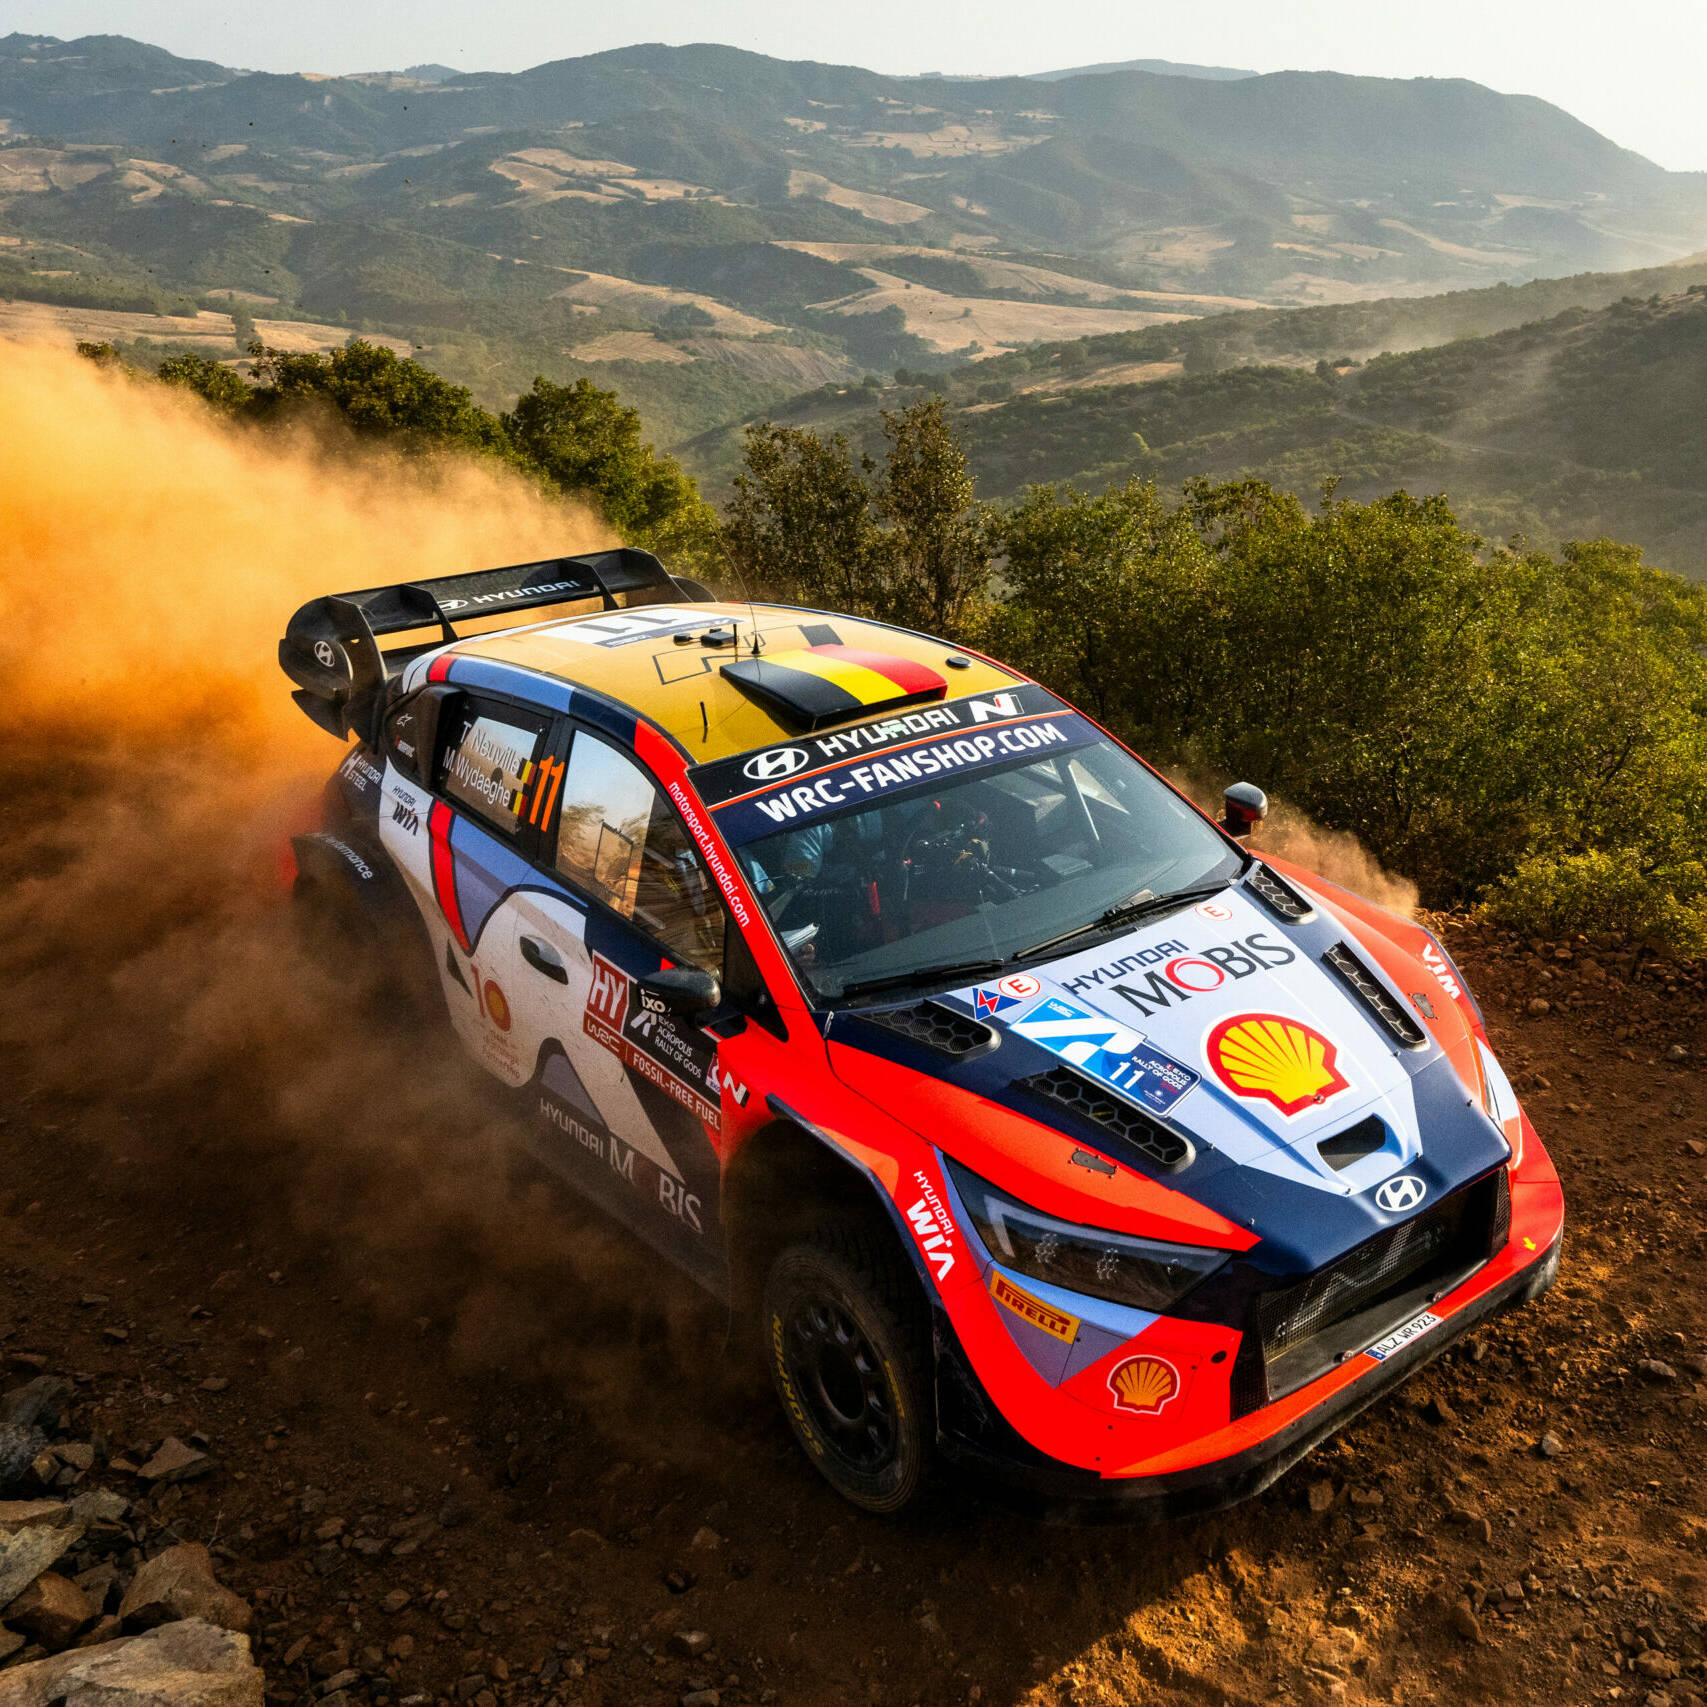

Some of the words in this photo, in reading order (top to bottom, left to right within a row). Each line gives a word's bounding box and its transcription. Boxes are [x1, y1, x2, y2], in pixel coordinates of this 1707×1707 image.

[472, 580, 581, 604] HYUNDAI
[356, 759, 384, 785] HYUNDAI
[442, 746, 455, 773] M.
[456, 754, 511, 807] Wydaeghe
[470, 729, 521, 775] Neuville
[754, 723, 1068, 823] WRC-FANSHOP.COM
[348, 770, 368, 792] STEEL
[391, 785, 417, 807] HYUNDAI
[529, 755, 565, 832] 11
[669, 781, 750, 927] motorsport.hyundai.com
[589, 964, 625, 1020] HY
[1060, 939, 1192, 995] HYUNDAI
[1110, 933, 1297, 1018] MOBIS
[587, 1019, 620, 1053] WRC
[654, 1036, 674, 1057] RALLY
[673, 1051, 685, 1065] OF
[683, 1056, 702, 1080] GODS
[656, 1026, 693, 1058] ACROPOLIS
[632, 1053, 693, 1107] FOSSIL-FREE
[695, 1102, 721, 1131] FUEL
[1109, 1061, 1146, 1090] 11
[540, 1097, 604, 1159] HYUNDAI
[913, 1170, 955, 1235] HYUNDAI
[996, 1278, 1071, 1337] PIRELLI
[1376, 1337, 1403, 1354] ALZ
[1397, 1327, 1416, 1340] WR
[1411, 1314, 1437, 1330] 923
